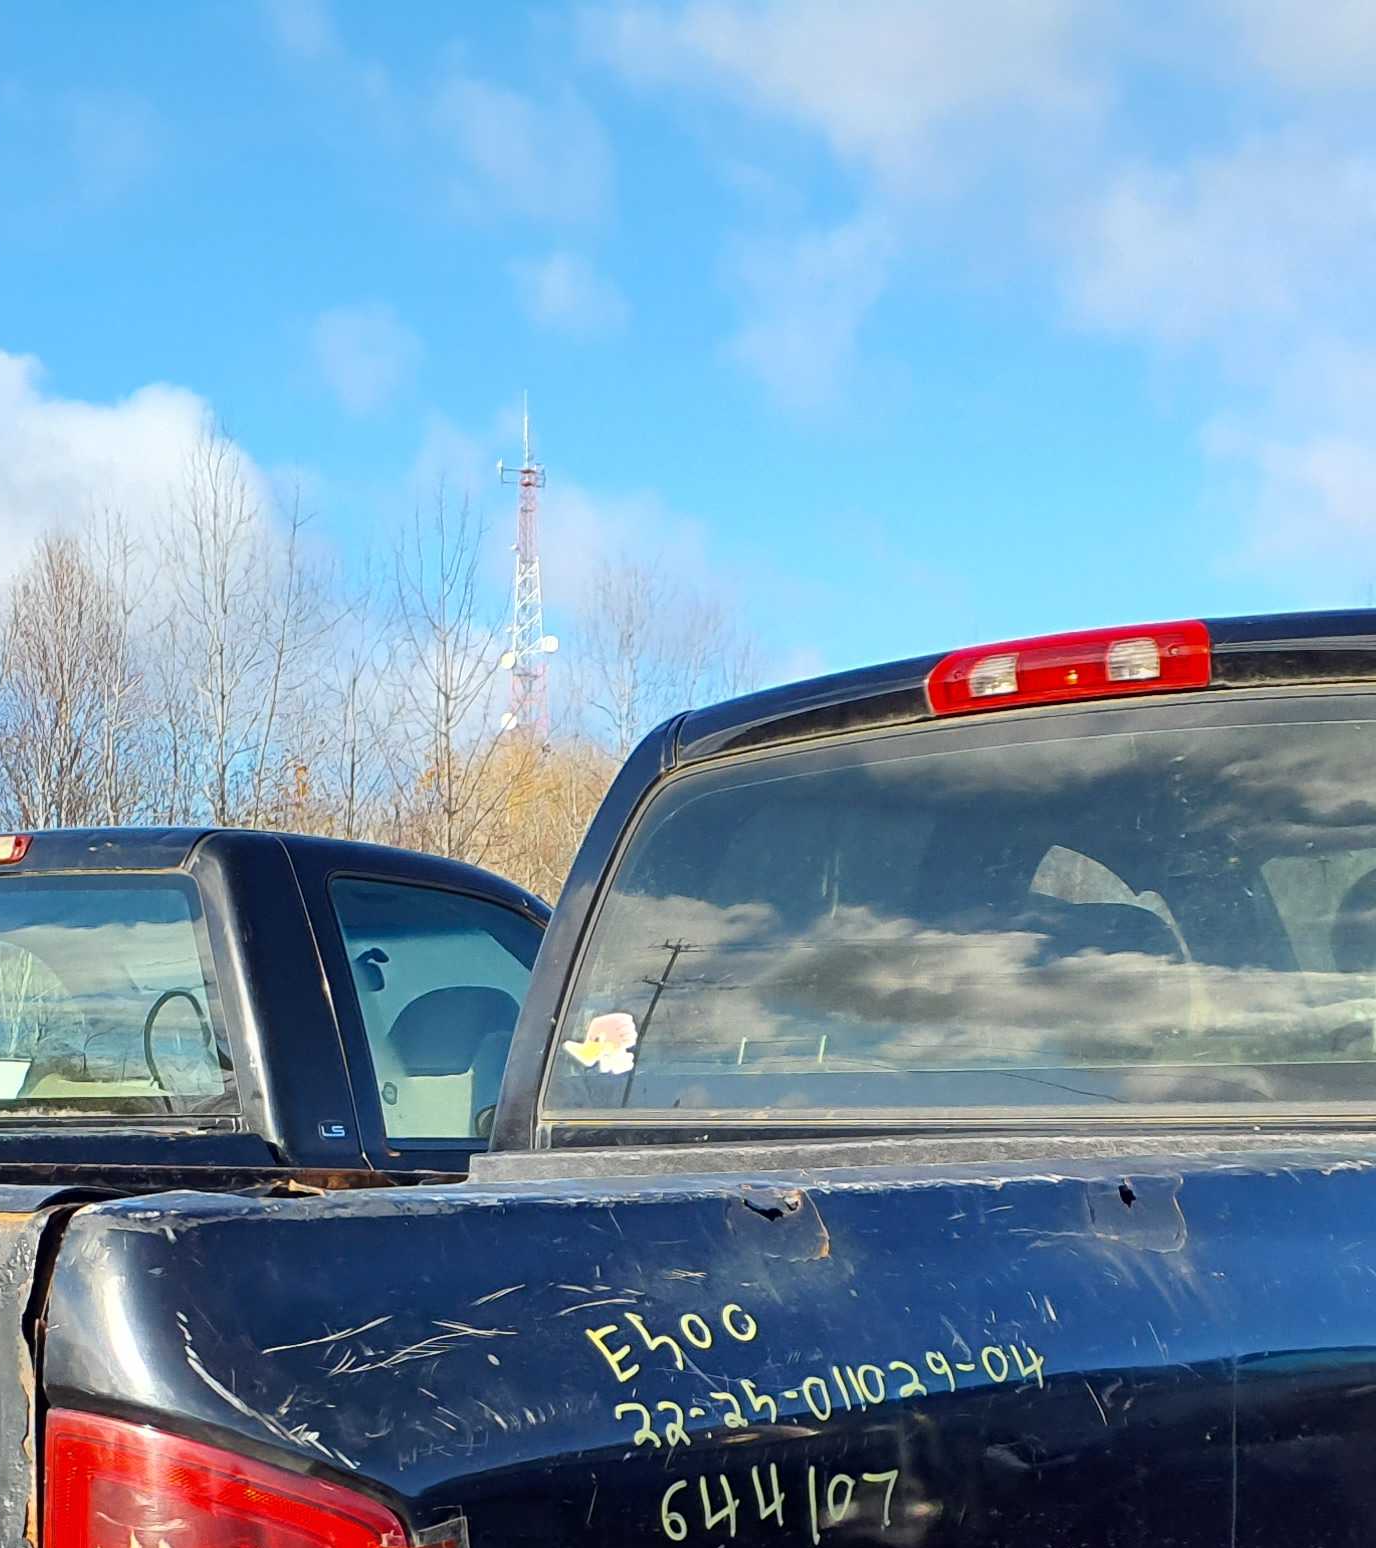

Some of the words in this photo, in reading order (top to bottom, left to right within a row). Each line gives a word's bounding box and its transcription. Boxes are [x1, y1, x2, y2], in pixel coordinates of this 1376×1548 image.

[320, 1124, 345, 1137] LS
[587, 1304, 757, 1383] E500
[615, 1343, 1044, 1447] 22-25-011029-04
[661, 1463, 898, 1545] 644107
